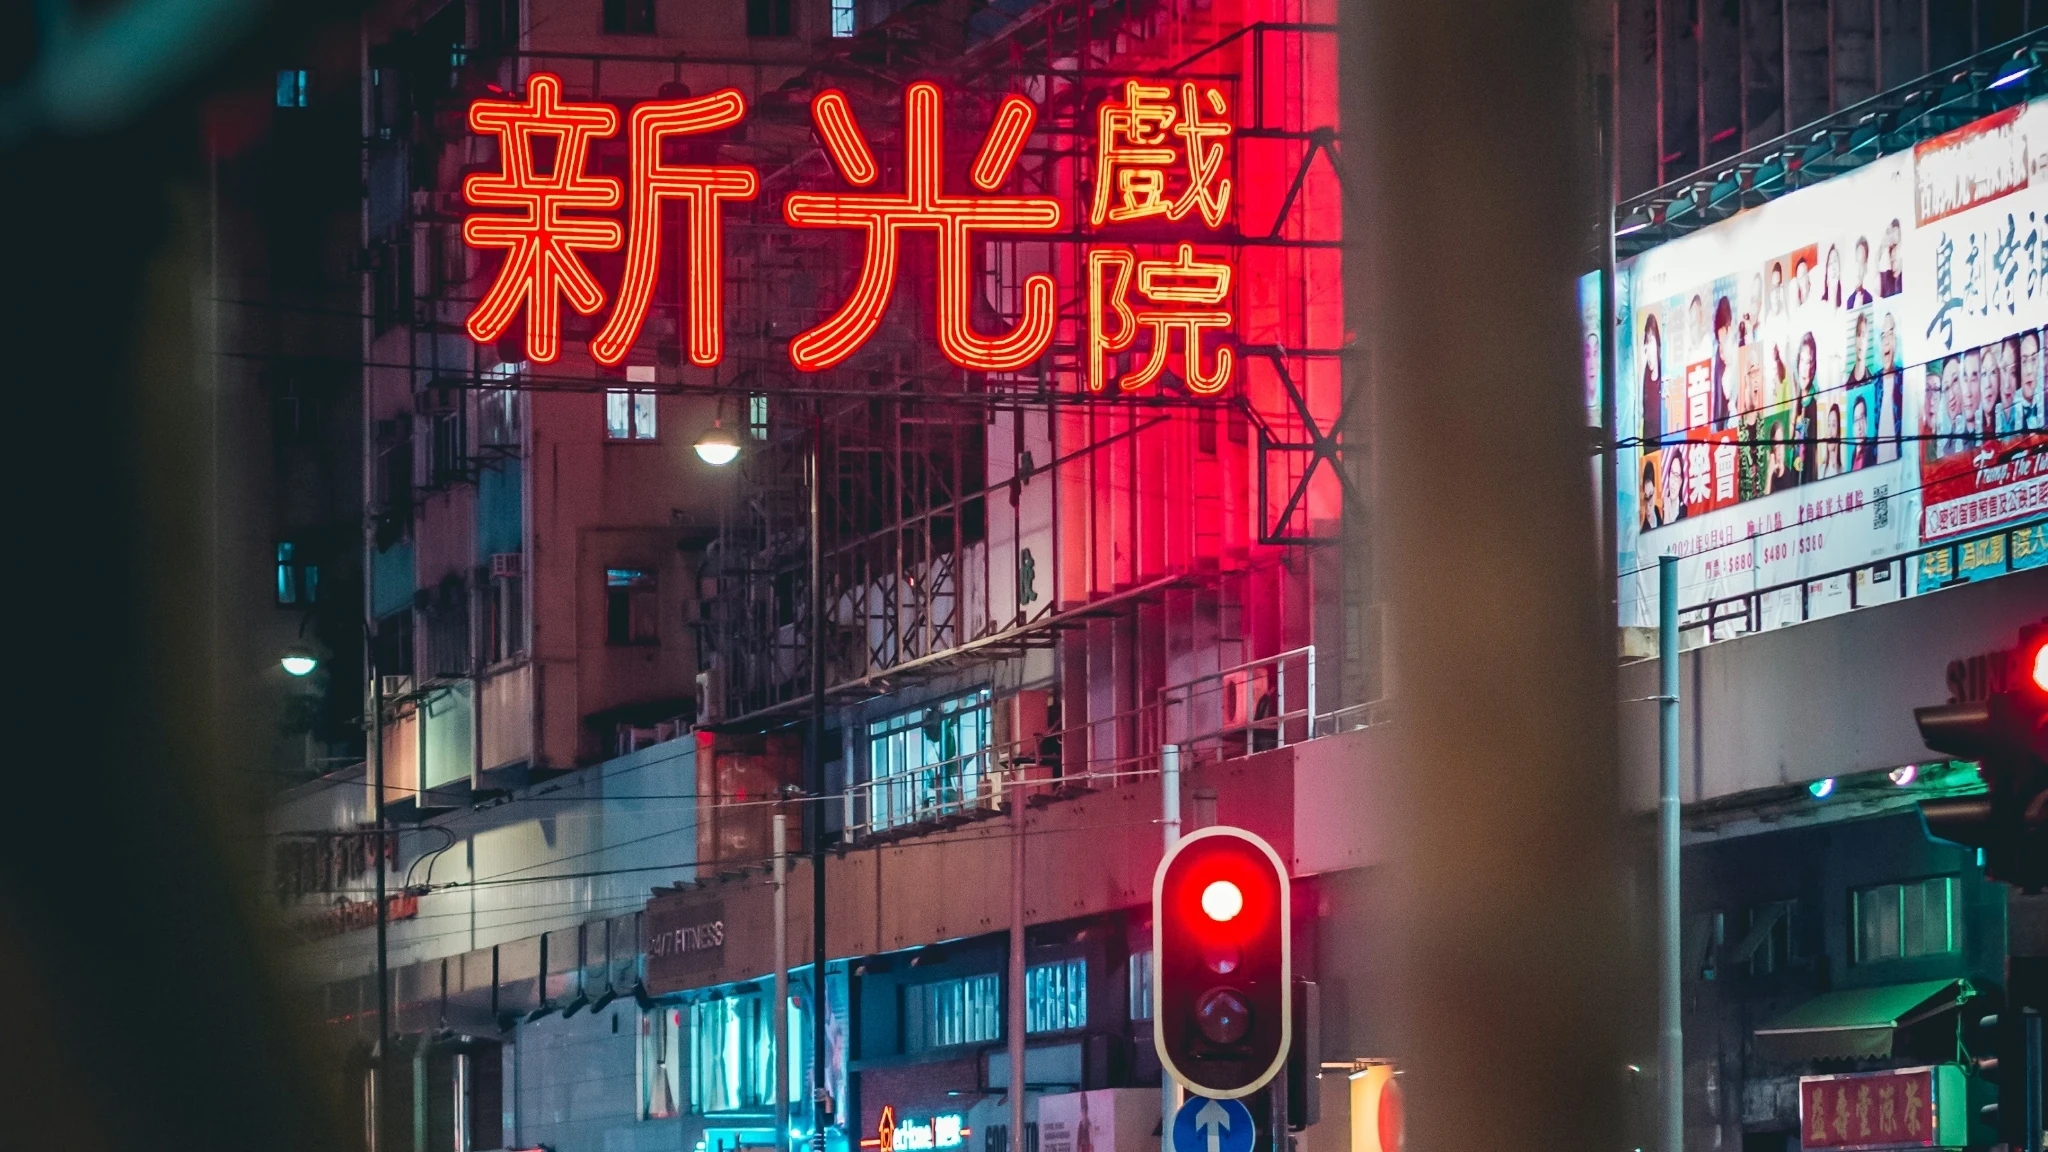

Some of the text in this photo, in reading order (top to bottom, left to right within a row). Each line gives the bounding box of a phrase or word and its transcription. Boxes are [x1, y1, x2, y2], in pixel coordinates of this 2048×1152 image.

[464, 72, 1234, 396] 新光 戲院
[1687, 365, 1711, 430] 音
[1688, 434, 1738, 503] 樂會
[1764, 542, 1787, 564] $480
[1799, 533, 1823, 554] $380
[675, 920, 724, 954] FITNESS
